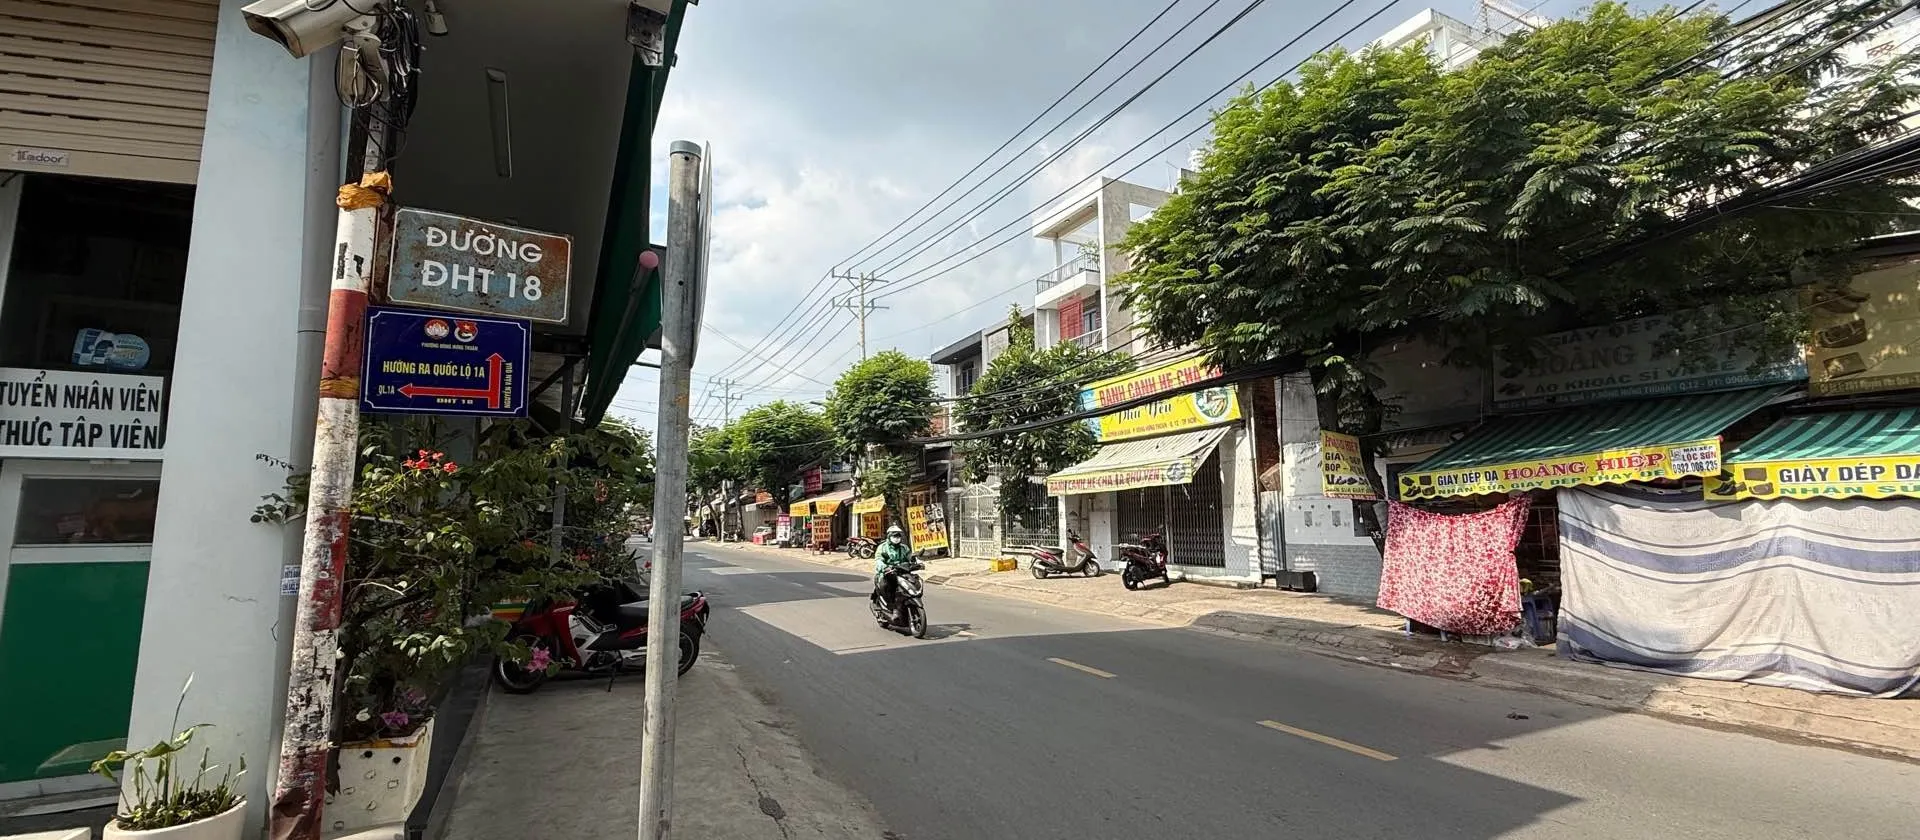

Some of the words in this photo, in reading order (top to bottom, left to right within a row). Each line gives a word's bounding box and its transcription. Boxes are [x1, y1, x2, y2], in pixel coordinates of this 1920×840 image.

[426, 226, 543, 263] ĐƯỜNG
[421, 259, 494, 294] ĐHT
[507, 272, 542, 301] 18
[418, 362, 430, 375] RA
[433, 360, 457, 376] QUỐC
[460, 365, 471, 380] LỘ
[474, 367, 485, 378] 1A
[0, 370, 58, 408] TUYỂN
[63, 379, 114, 411] NHÂN
[119, 382, 160, 413] VIÊN
[378, 384, 395, 397] QL.1A
[110, 417, 158, 449] VIÊN
[1502, 460, 1588, 481] HOÀNG
[1596, 451, 1666, 471] HIỆP
[1588, 472, 1633, 482] THAY
[1779, 465, 1829, 483] GIÀY
[1838, 463, 1885, 481] DÉP
[913, 533, 933, 543] NAM
